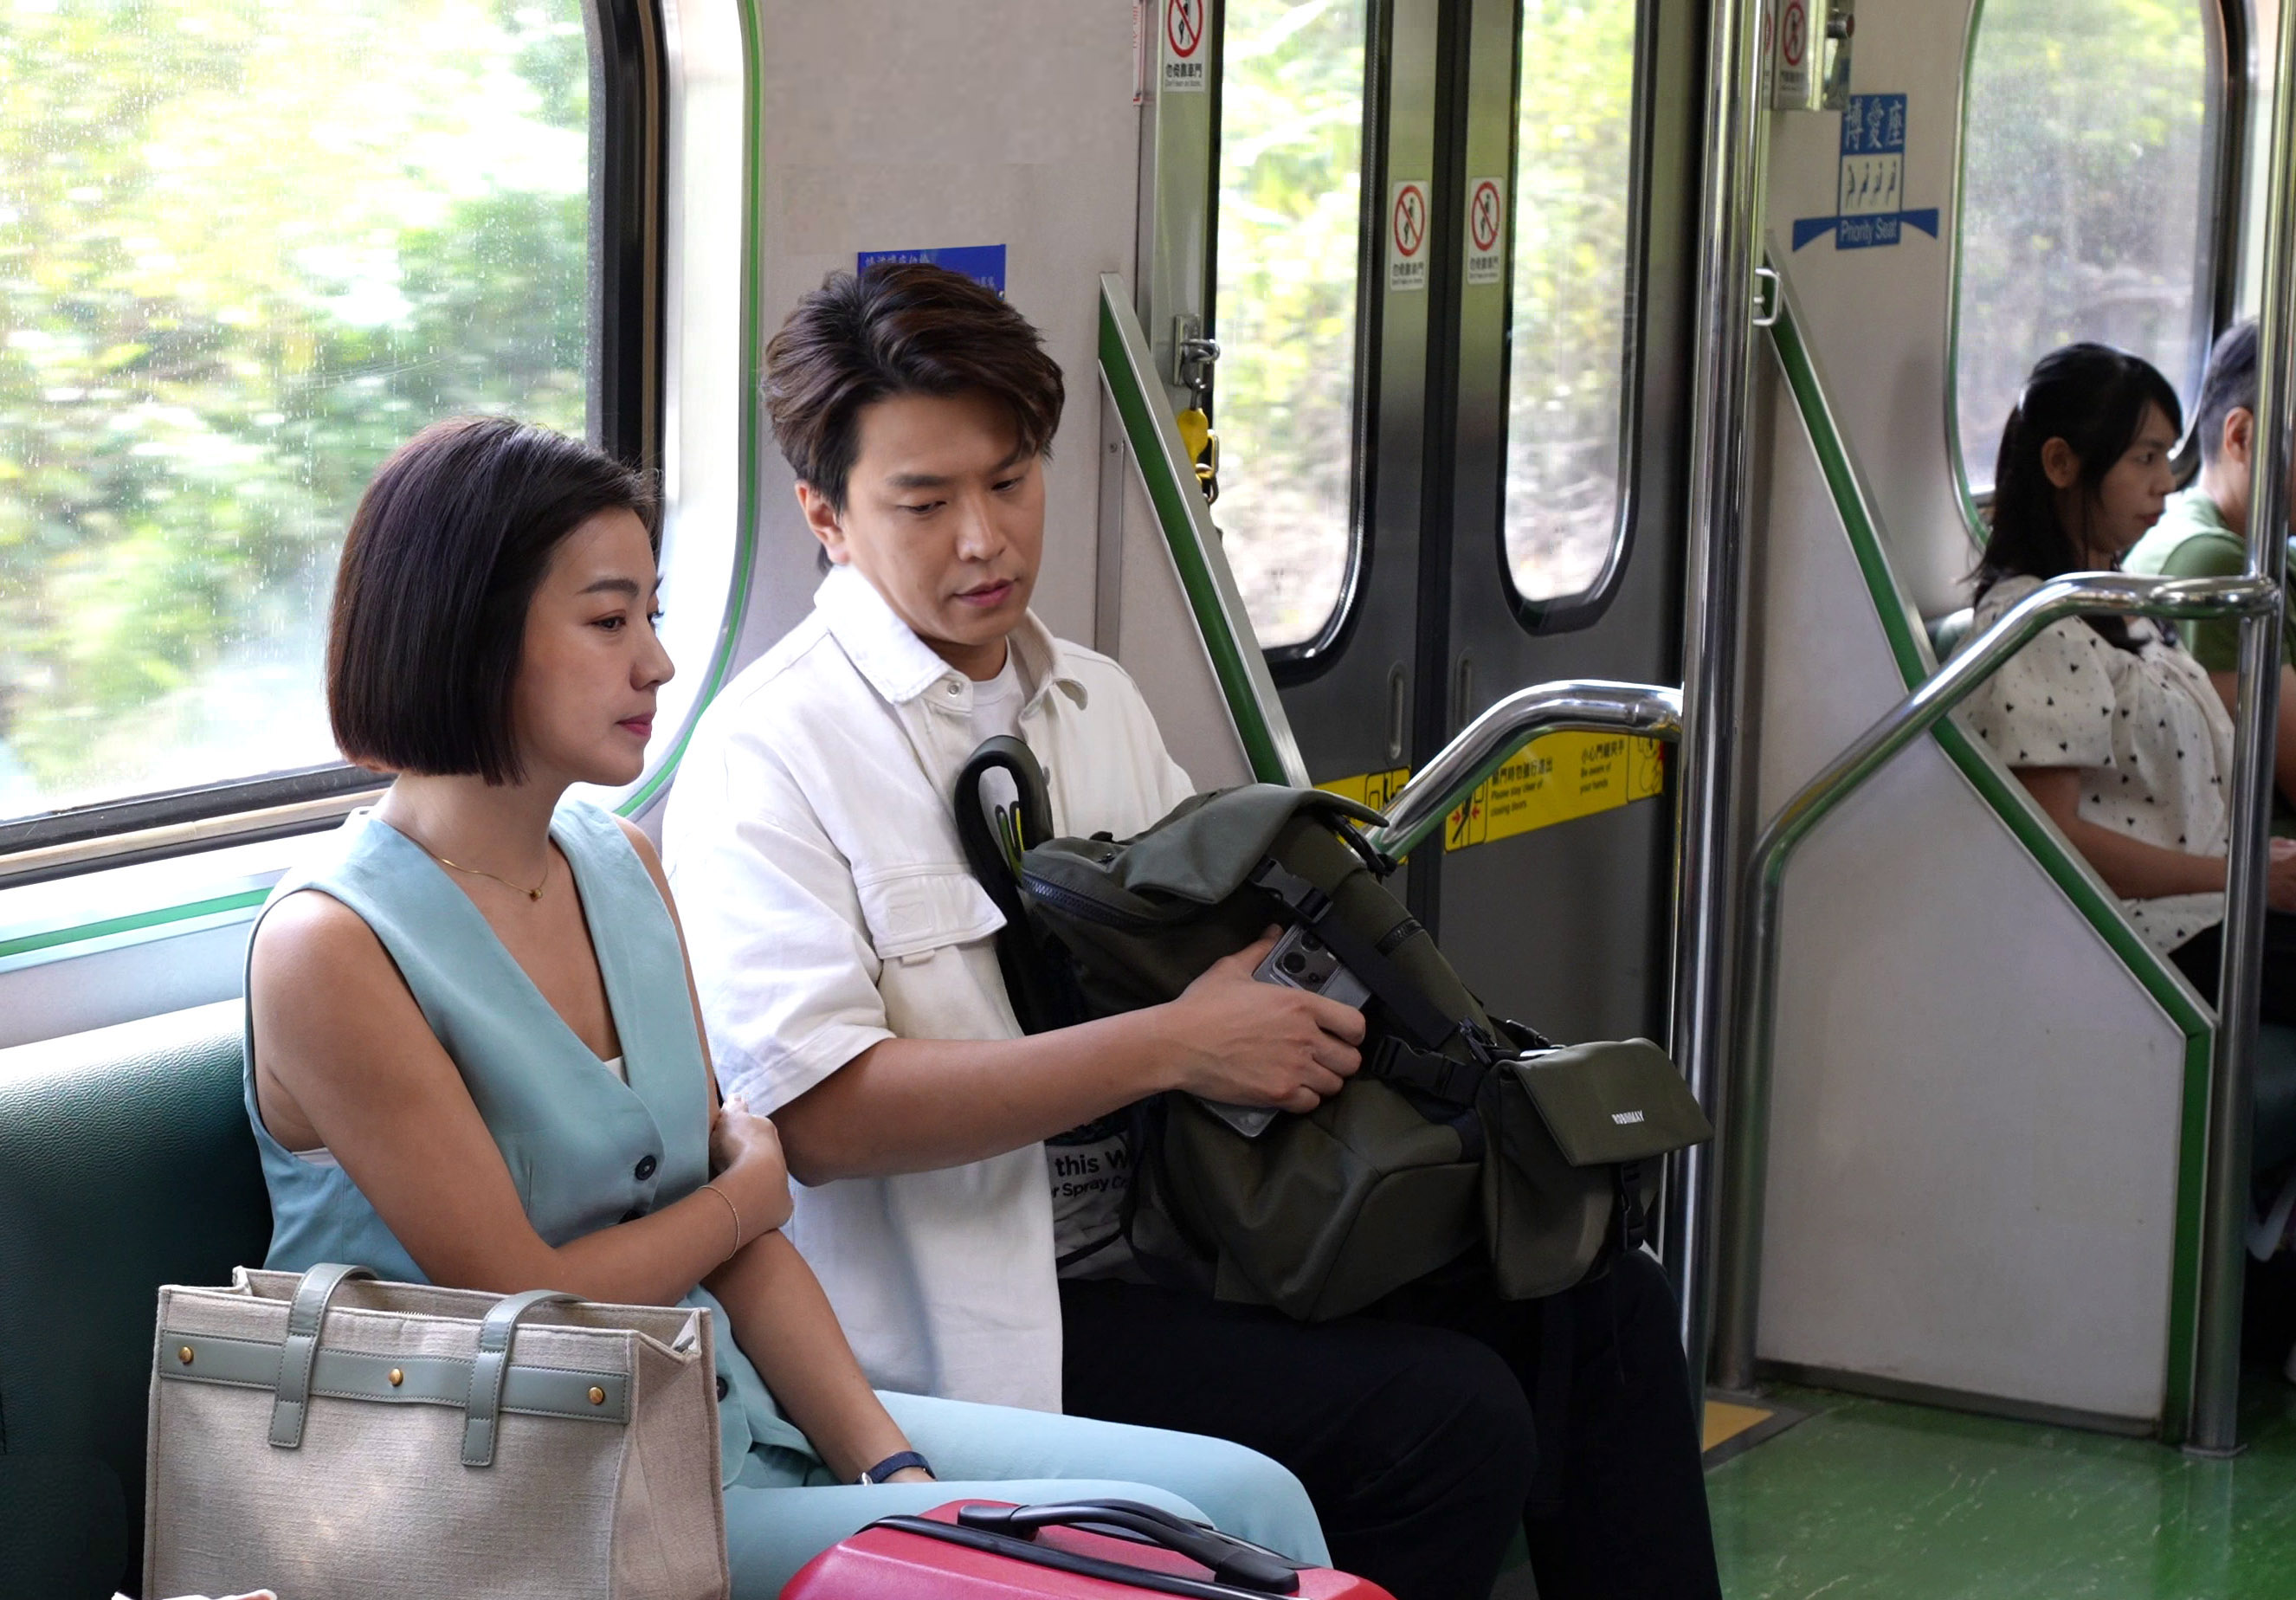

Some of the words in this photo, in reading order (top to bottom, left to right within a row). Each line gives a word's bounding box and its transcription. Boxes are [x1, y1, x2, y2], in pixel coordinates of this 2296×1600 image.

[1844, 97, 1904, 151] 博愛座
[1841, 220, 1873, 245] Priority
[1875, 216, 1898, 240] Seat
[1054, 1154, 1100, 1177] this
[1062, 1177, 1109, 1197] Spray
